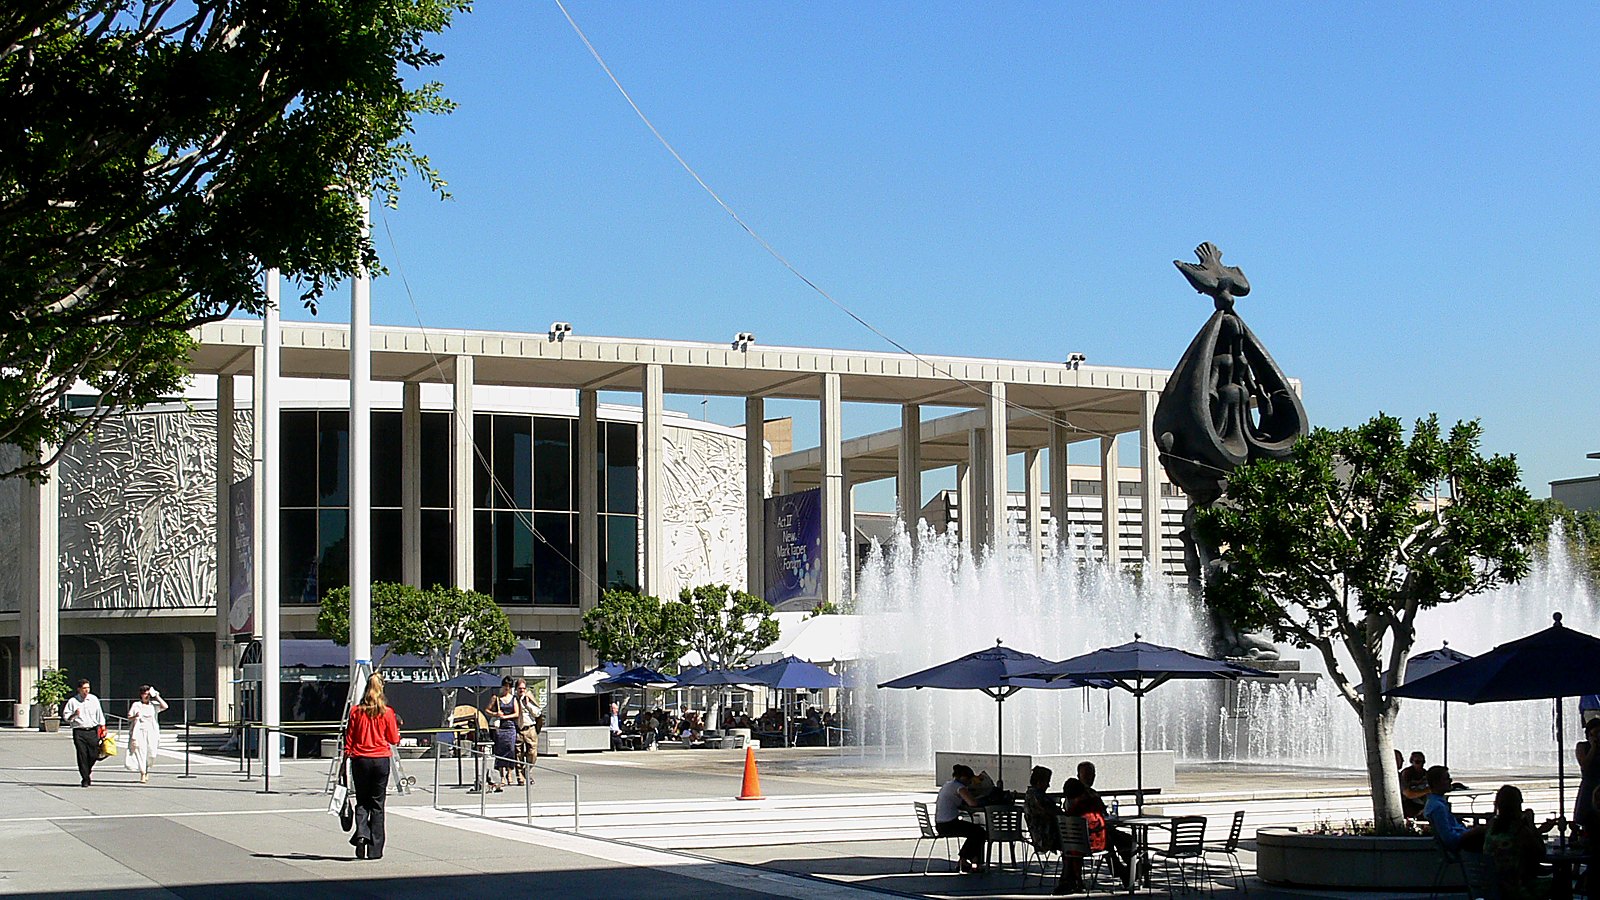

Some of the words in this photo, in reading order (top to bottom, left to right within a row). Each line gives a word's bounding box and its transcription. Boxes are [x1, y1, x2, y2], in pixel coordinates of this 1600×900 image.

[777, 516, 786, 528] Act
[777, 544, 790, 558] Mark
[790, 543, 806, 559] Taper
[783, 558, 801, 570] Forum
